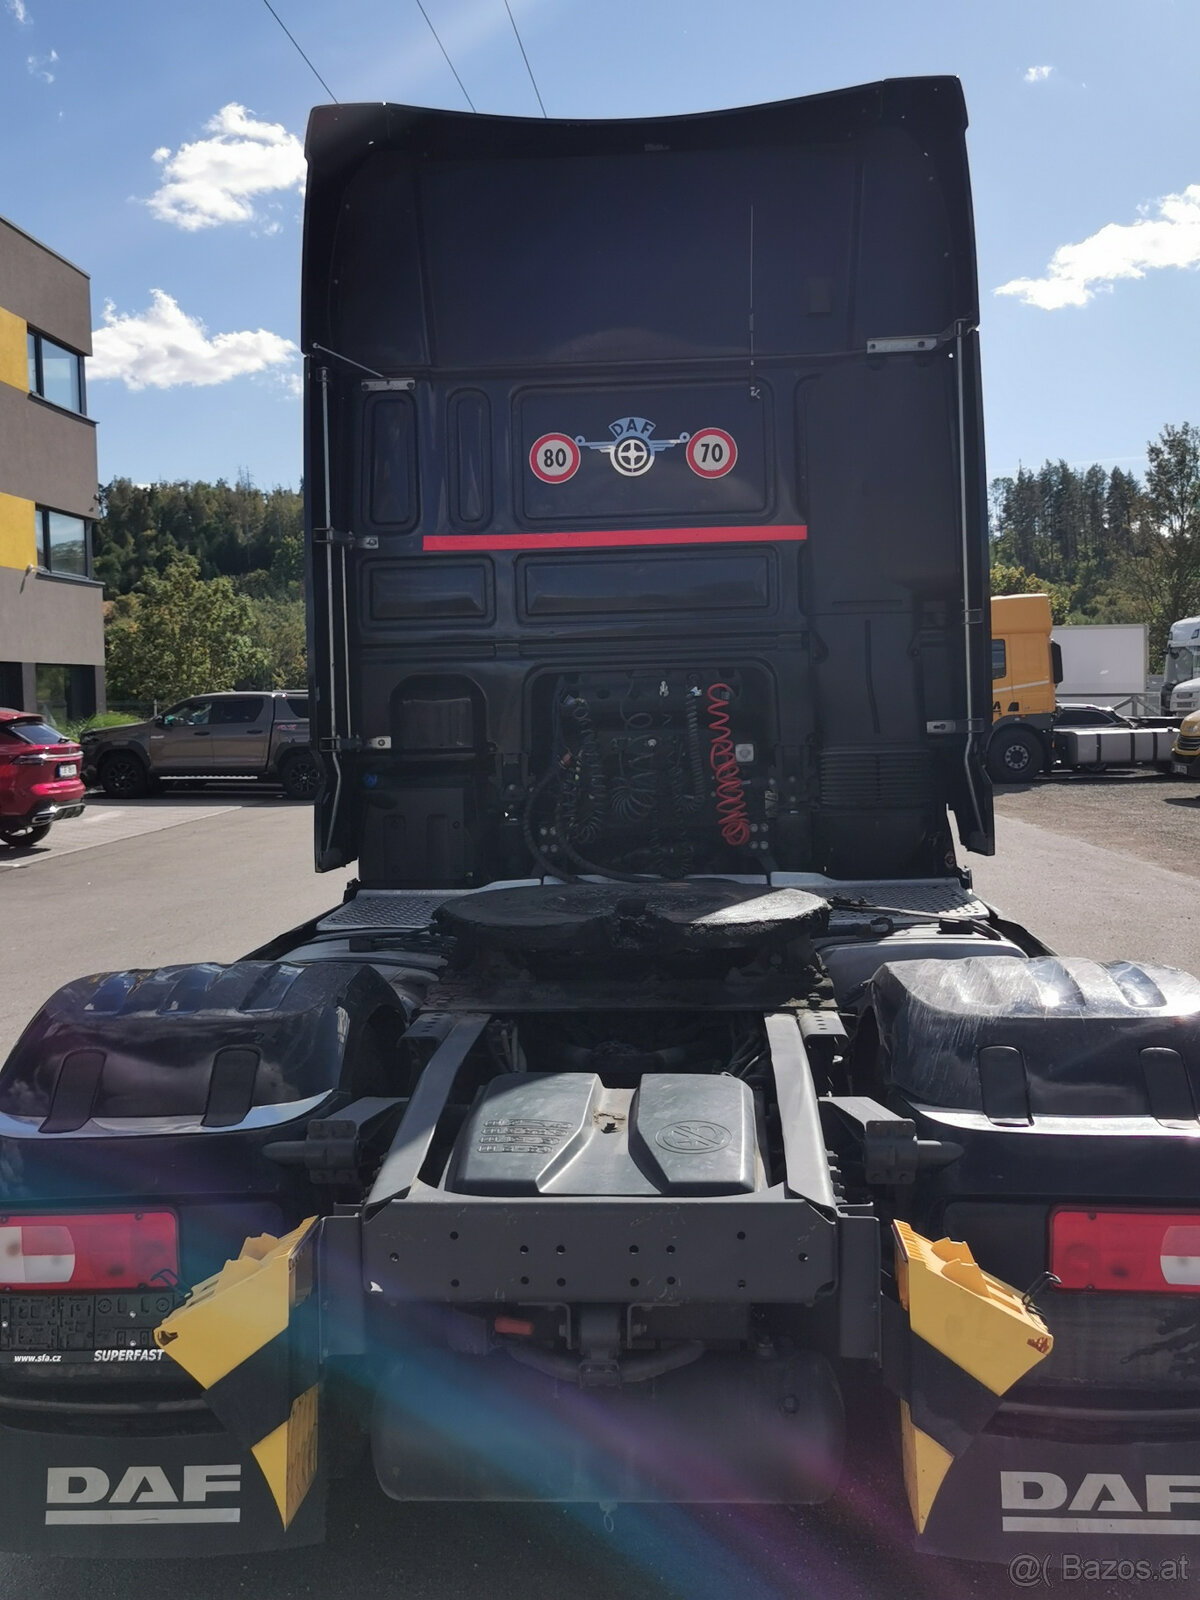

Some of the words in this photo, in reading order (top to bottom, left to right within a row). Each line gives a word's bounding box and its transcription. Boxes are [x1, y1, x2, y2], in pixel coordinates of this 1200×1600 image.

[610, 418, 655, 437] DAF
[543, 447, 567, 468] 80
[700, 443, 724, 463] 70
[14, 1353, 62, 1363] www.sfa.cz
[93, 1349, 165, 1362] SUPERFAST
[46, 1464, 242, 1504] DAF
[1000, 1471, 1200, 1512] DAF
